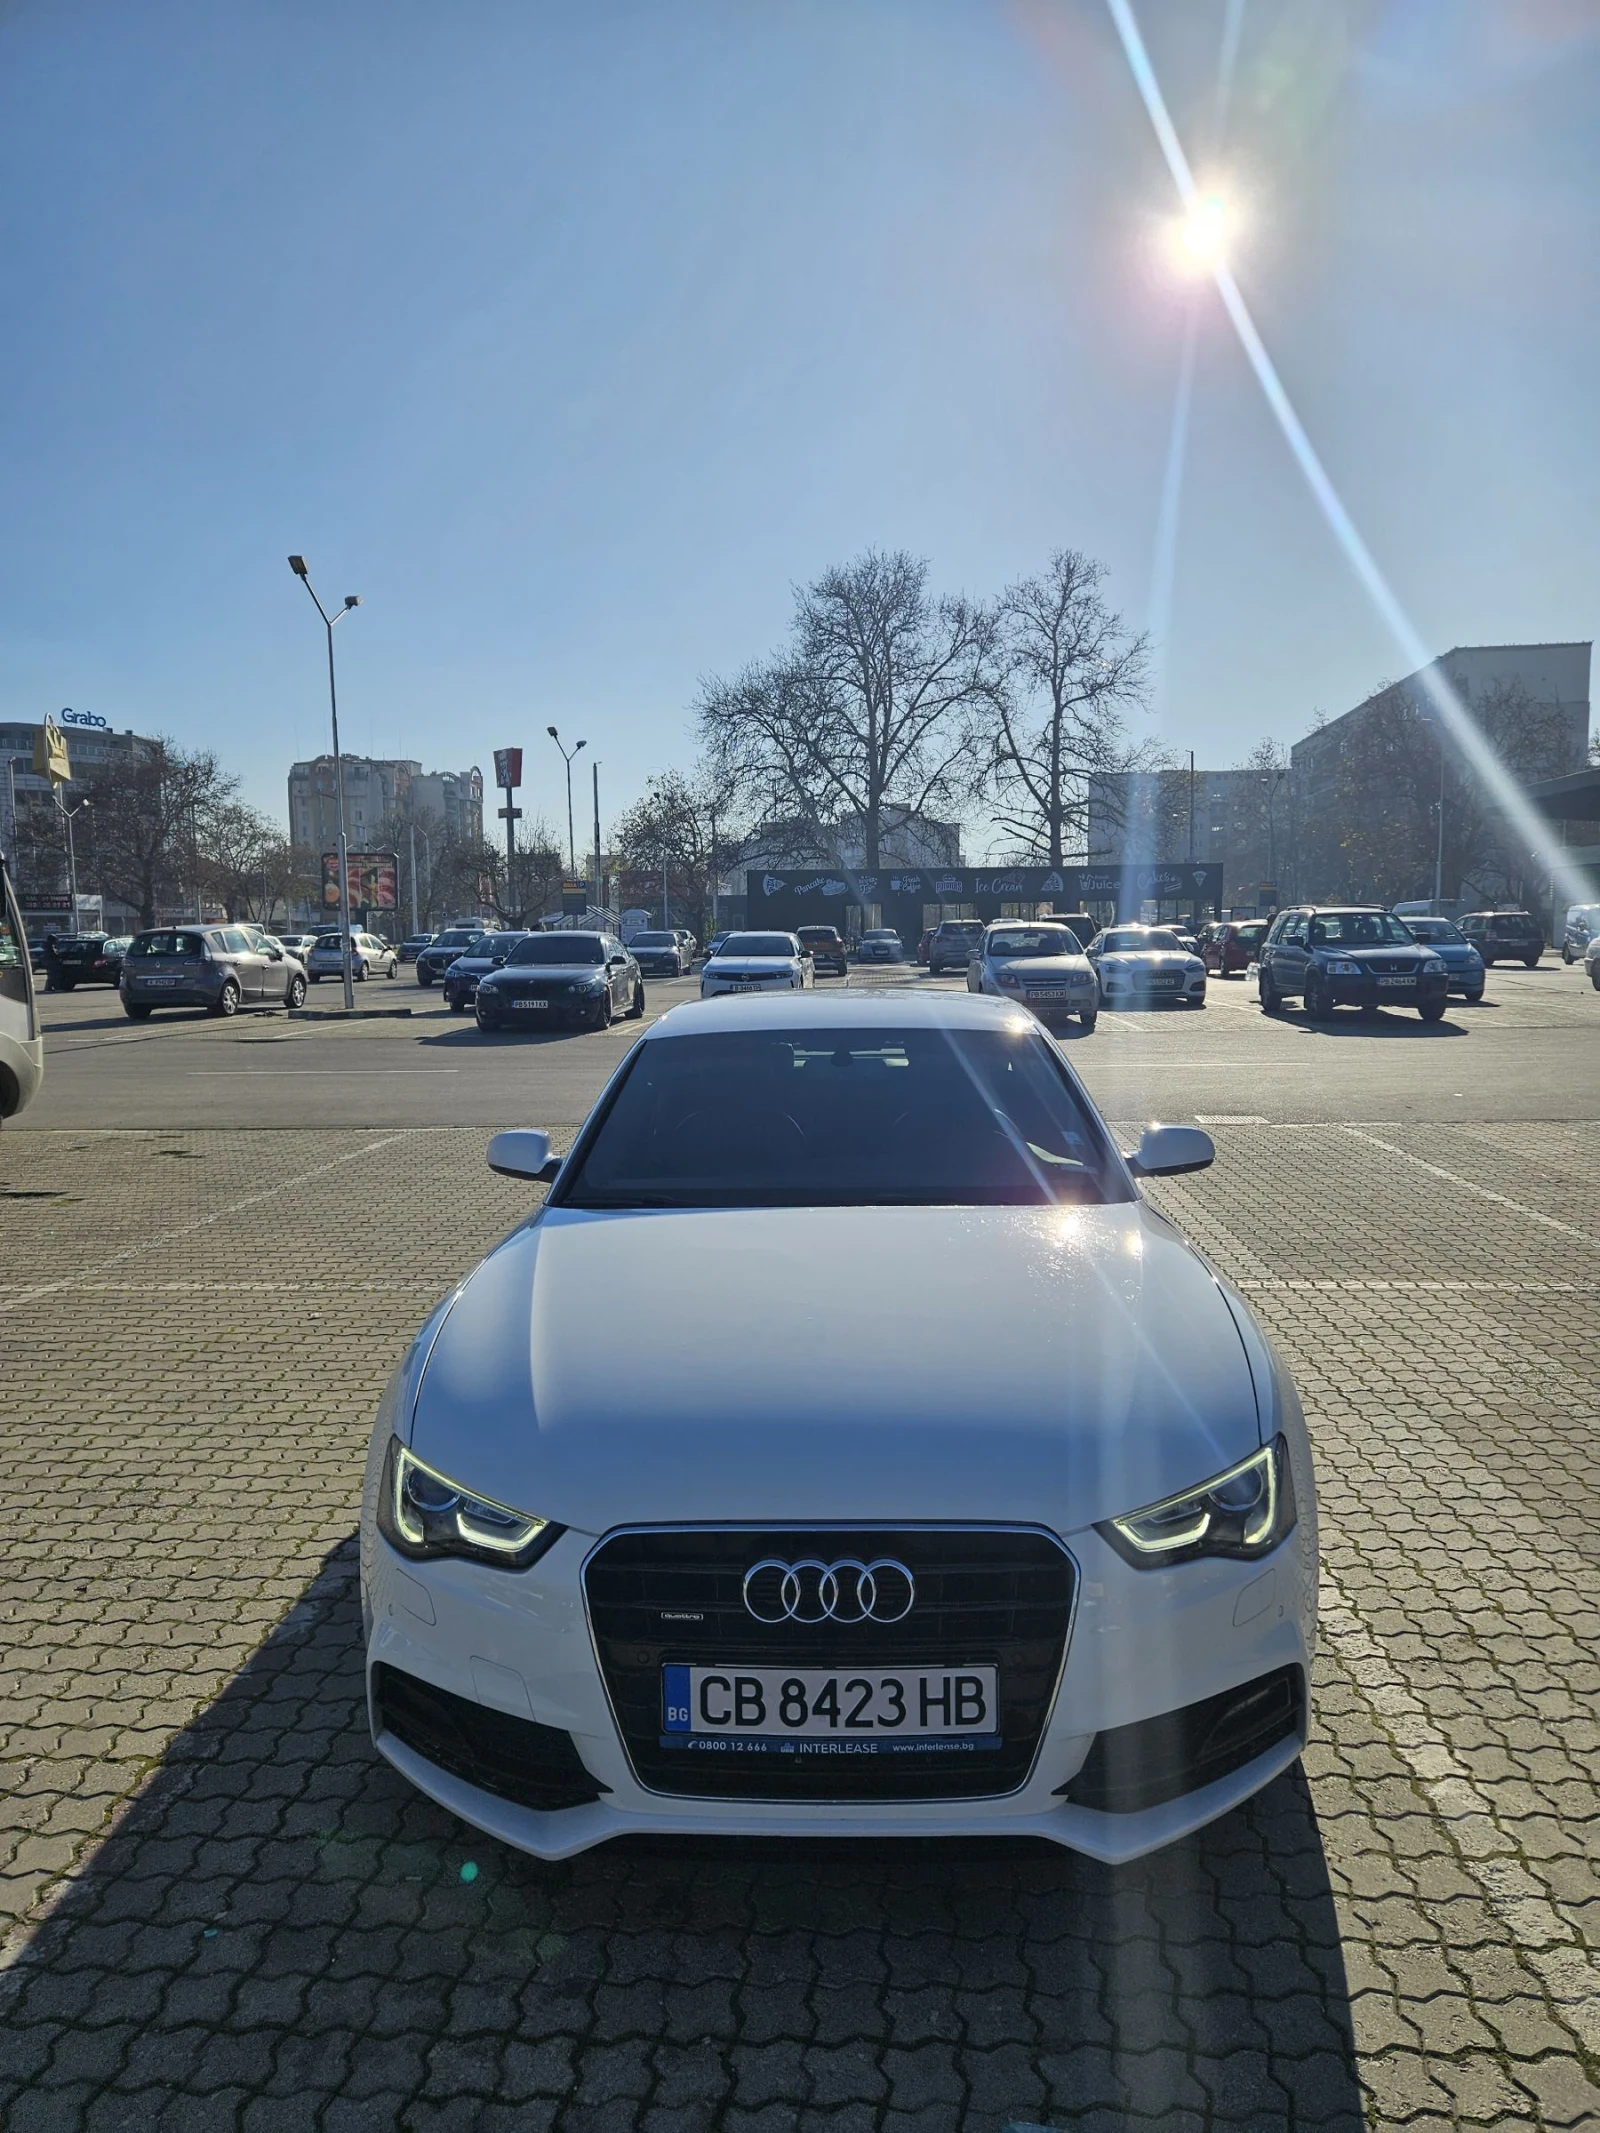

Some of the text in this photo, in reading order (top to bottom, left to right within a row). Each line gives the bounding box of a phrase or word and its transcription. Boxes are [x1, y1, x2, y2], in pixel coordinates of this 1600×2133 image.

[61, 707, 107, 727] Grabo
[794, 877, 825, 896] Pancake
[975, 877, 1023, 894] Ice Cream
[1090, 878, 1121, 890] Juice
[1137, 870, 1170, 890] Cakes
[700, 1675, 987, 1728] CB 8423 HB
[667, 1706, 689, 1722] BG
[698, 1741, 767, 1752] 0800 12 666
[799, 1743, 878, 1754] INTERLEASE
[892, 1742, 974, 1751] www.interlease.bg
